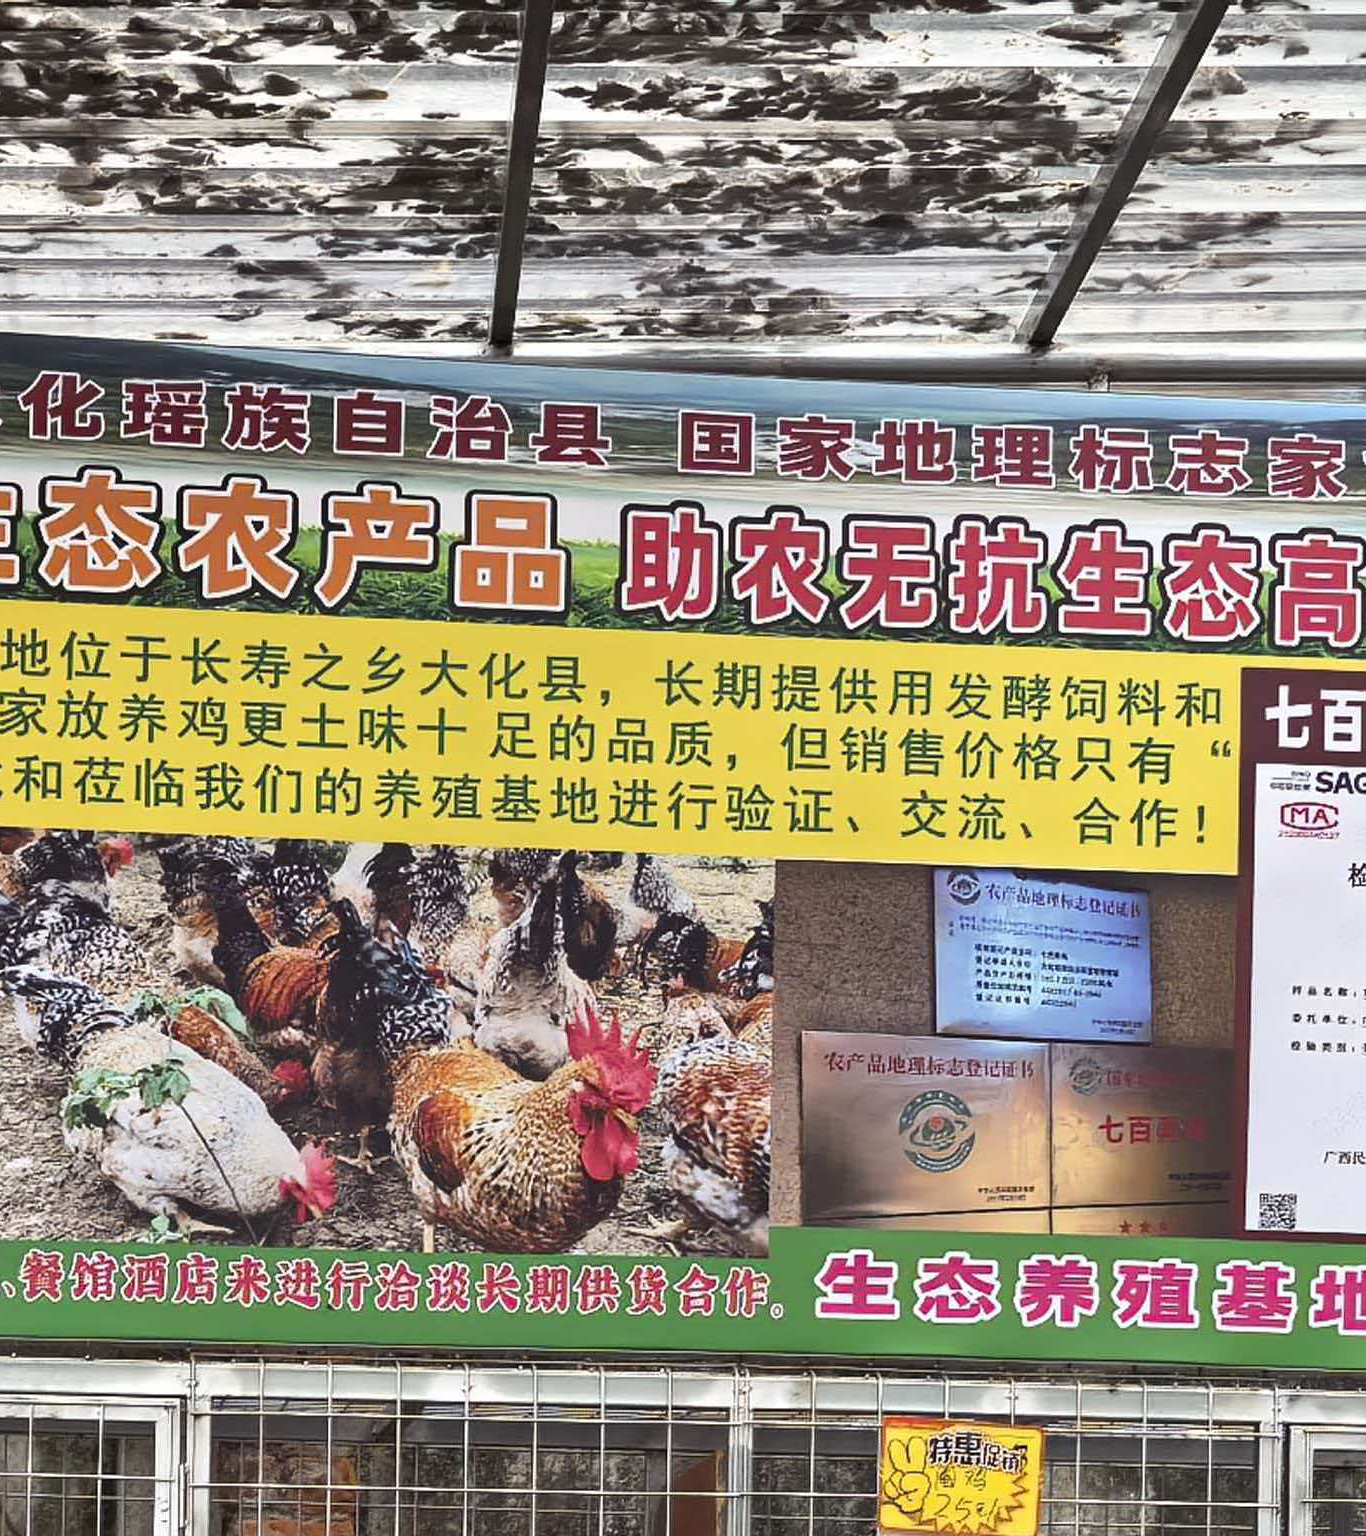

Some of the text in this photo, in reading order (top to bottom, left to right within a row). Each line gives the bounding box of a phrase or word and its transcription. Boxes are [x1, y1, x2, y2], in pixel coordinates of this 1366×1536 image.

[825, 1053, 1035, 1078] 农产品地理标志登记证书
[1098, 1114, 1204, 1144] 七百
[929, 1432, 1028, 1472] 特惠促销
